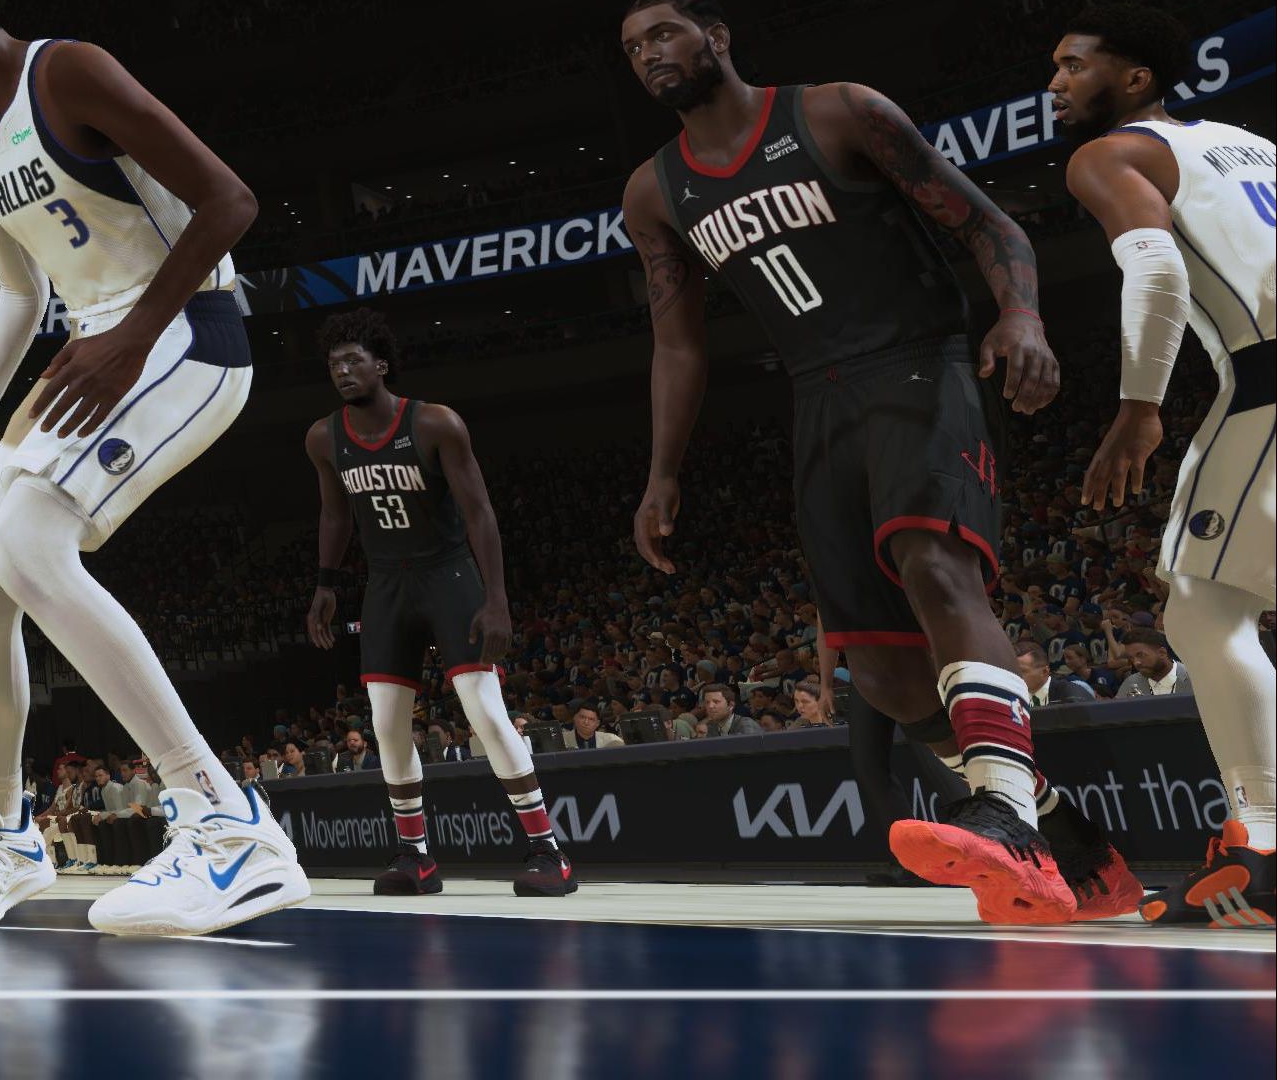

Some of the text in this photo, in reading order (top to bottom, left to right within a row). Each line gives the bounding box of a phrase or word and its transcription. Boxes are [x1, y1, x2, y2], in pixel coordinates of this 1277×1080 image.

[1202, 145, 1276, 177] MITCHEL
[43, 198, 91, 250] 3
[687, 180, 838, 272] HOUSTON
[355, 208, 634, 297] MAVERICK
[750, 243, 824, 317] 10
[341, 463, 427, 494] HOUSTON
[371, 494, 411, 529] 53
[1140, 762, 1233, 832] tha
[301, 811, 389, 849] Movement
[433, 803, 515, 857] inspires
